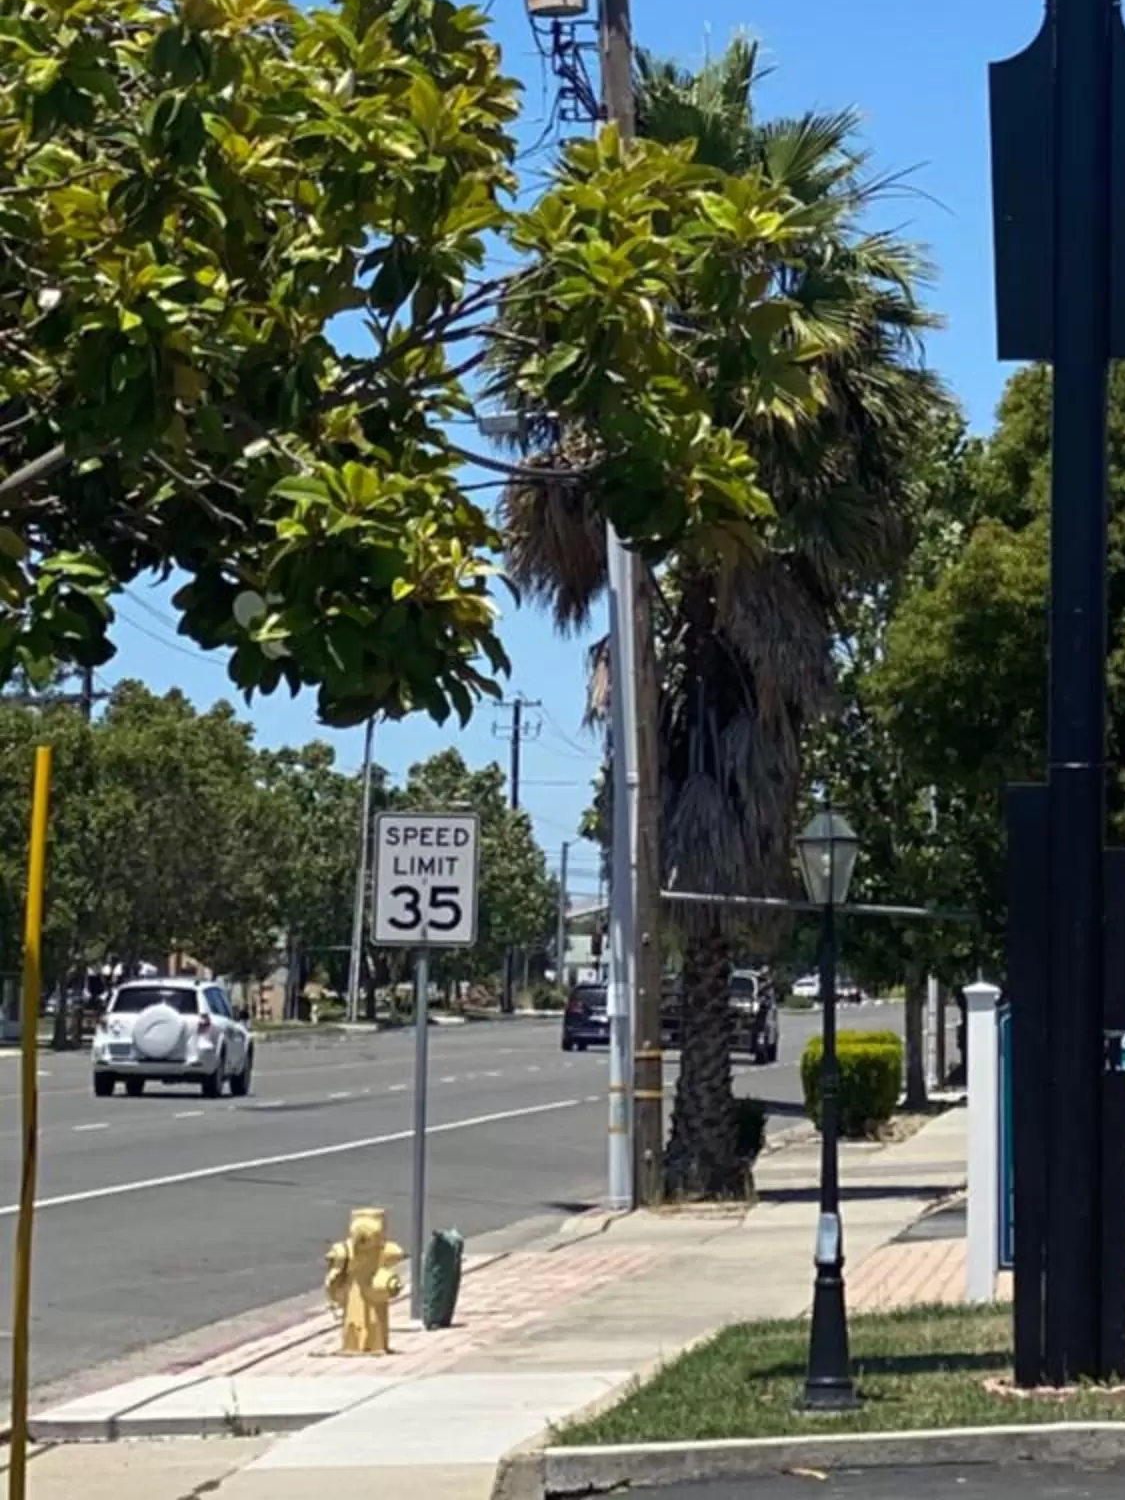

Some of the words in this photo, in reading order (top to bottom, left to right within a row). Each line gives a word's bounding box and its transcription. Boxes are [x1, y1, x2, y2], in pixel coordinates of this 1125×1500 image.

[385, 826, 470, 847] SPEED
[393, 856, 459, 876] LIMIT
[388, 885, 463, 932] 35
